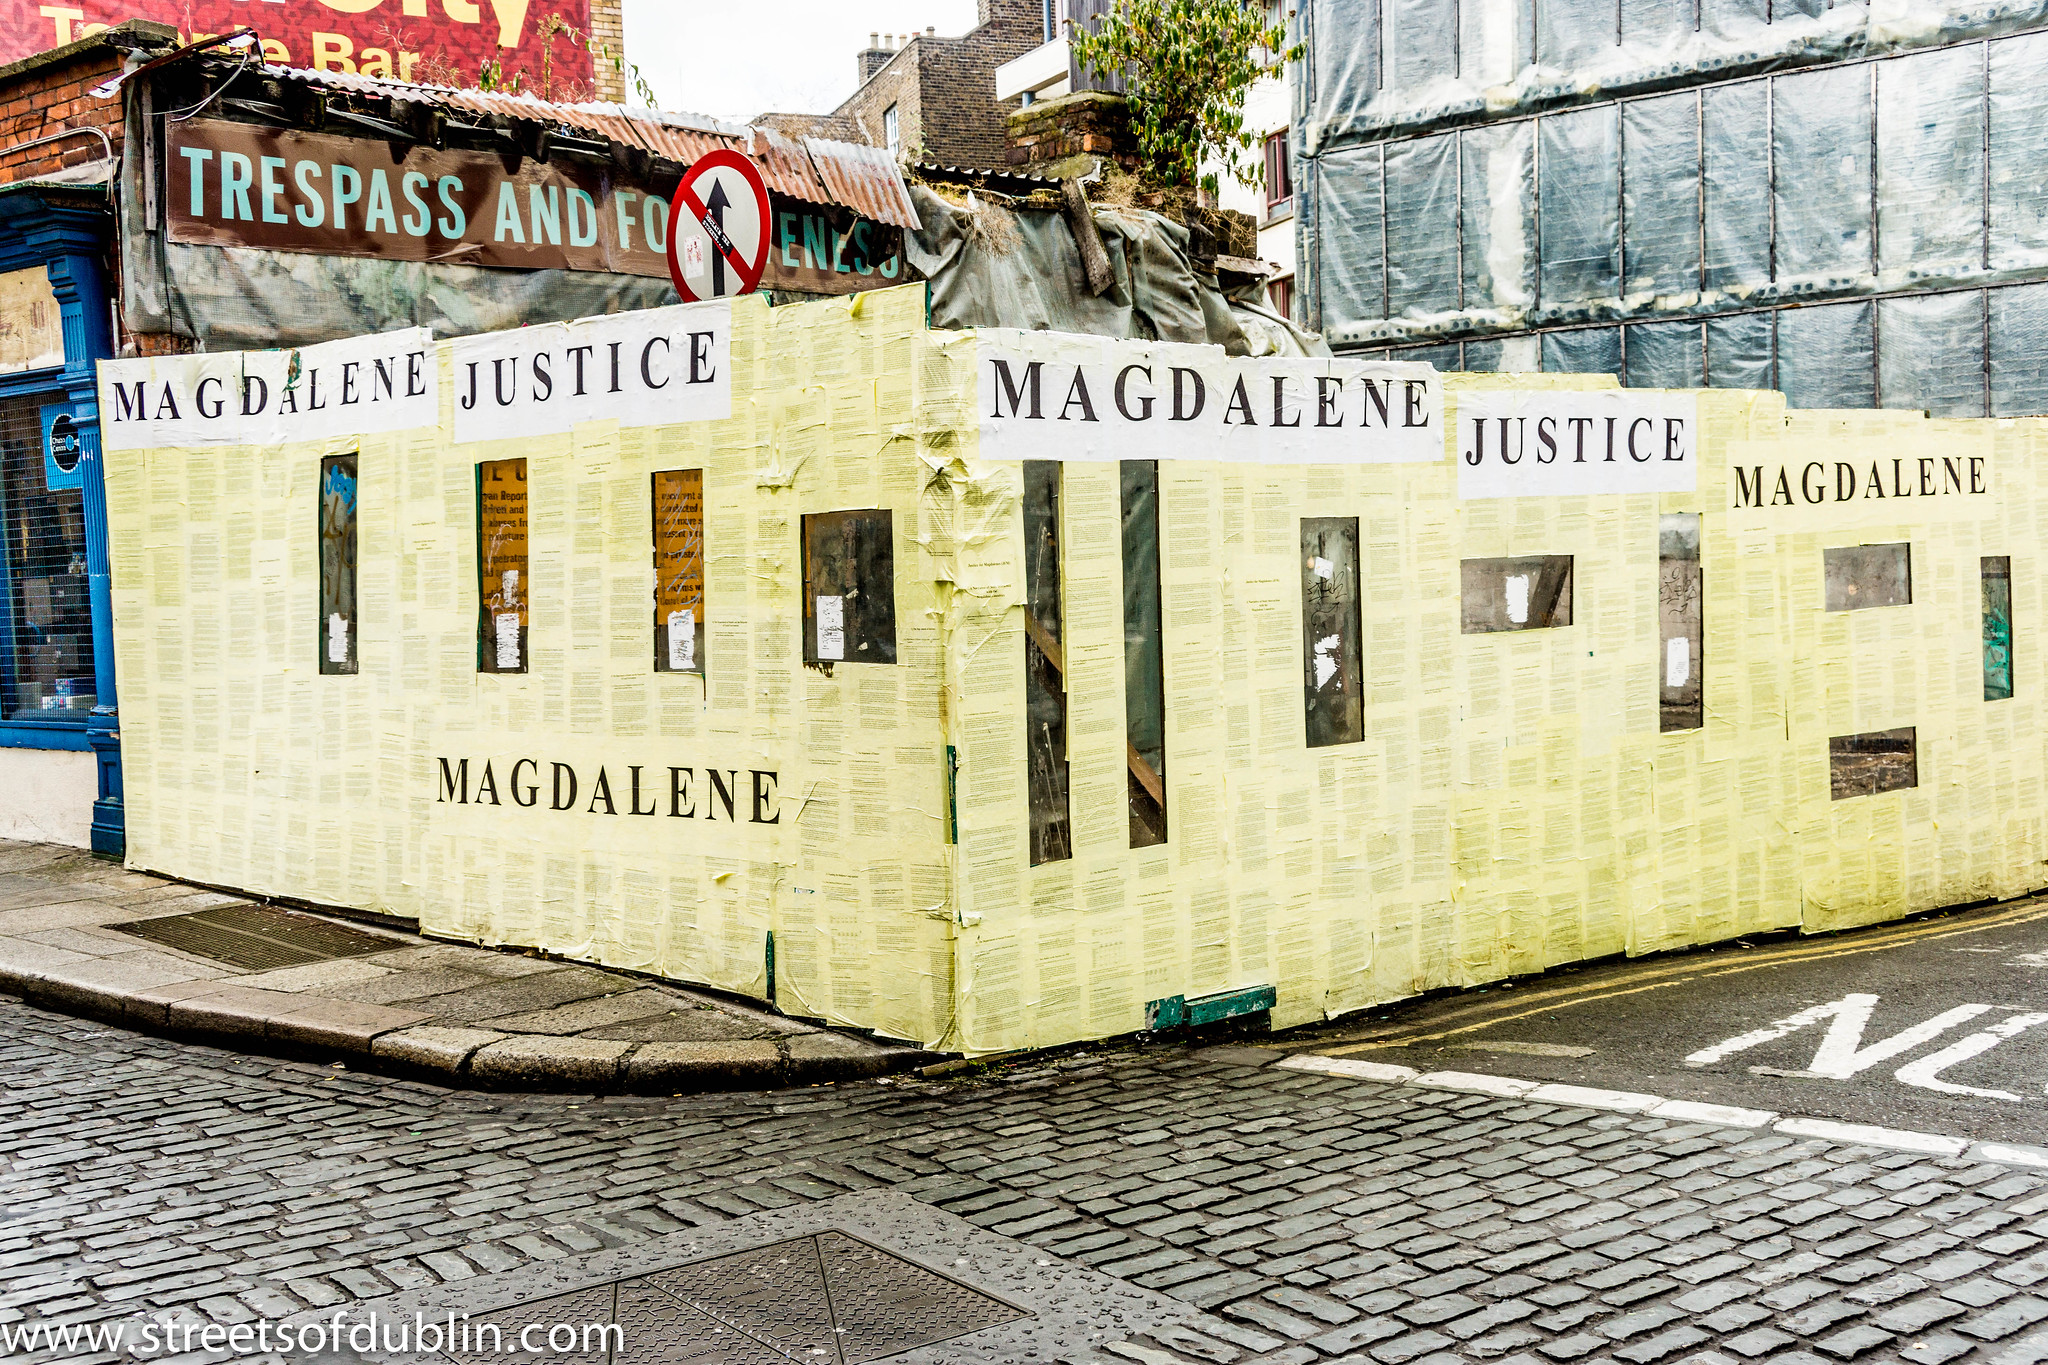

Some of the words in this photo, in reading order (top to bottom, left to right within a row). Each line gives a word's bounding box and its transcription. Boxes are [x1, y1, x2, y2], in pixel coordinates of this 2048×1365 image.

[312, 31, 419, 84] Bar
[180, 146, 466, 240] TRESPASS
[494, 182, 597, 248] AND
[111, 350, 427, 421] MAGDALENE
[461, 331, 717, 411] JUSTICE
[988, 359, 1430, 429] MAGDALENE
[1465, 416, 1685, 467] JUSTICE
[500, 490, 528, 502] Report
[1733, 457, 1987, 508] MAGDALENE
[436, 757, 781, 825] MAGDALENE
